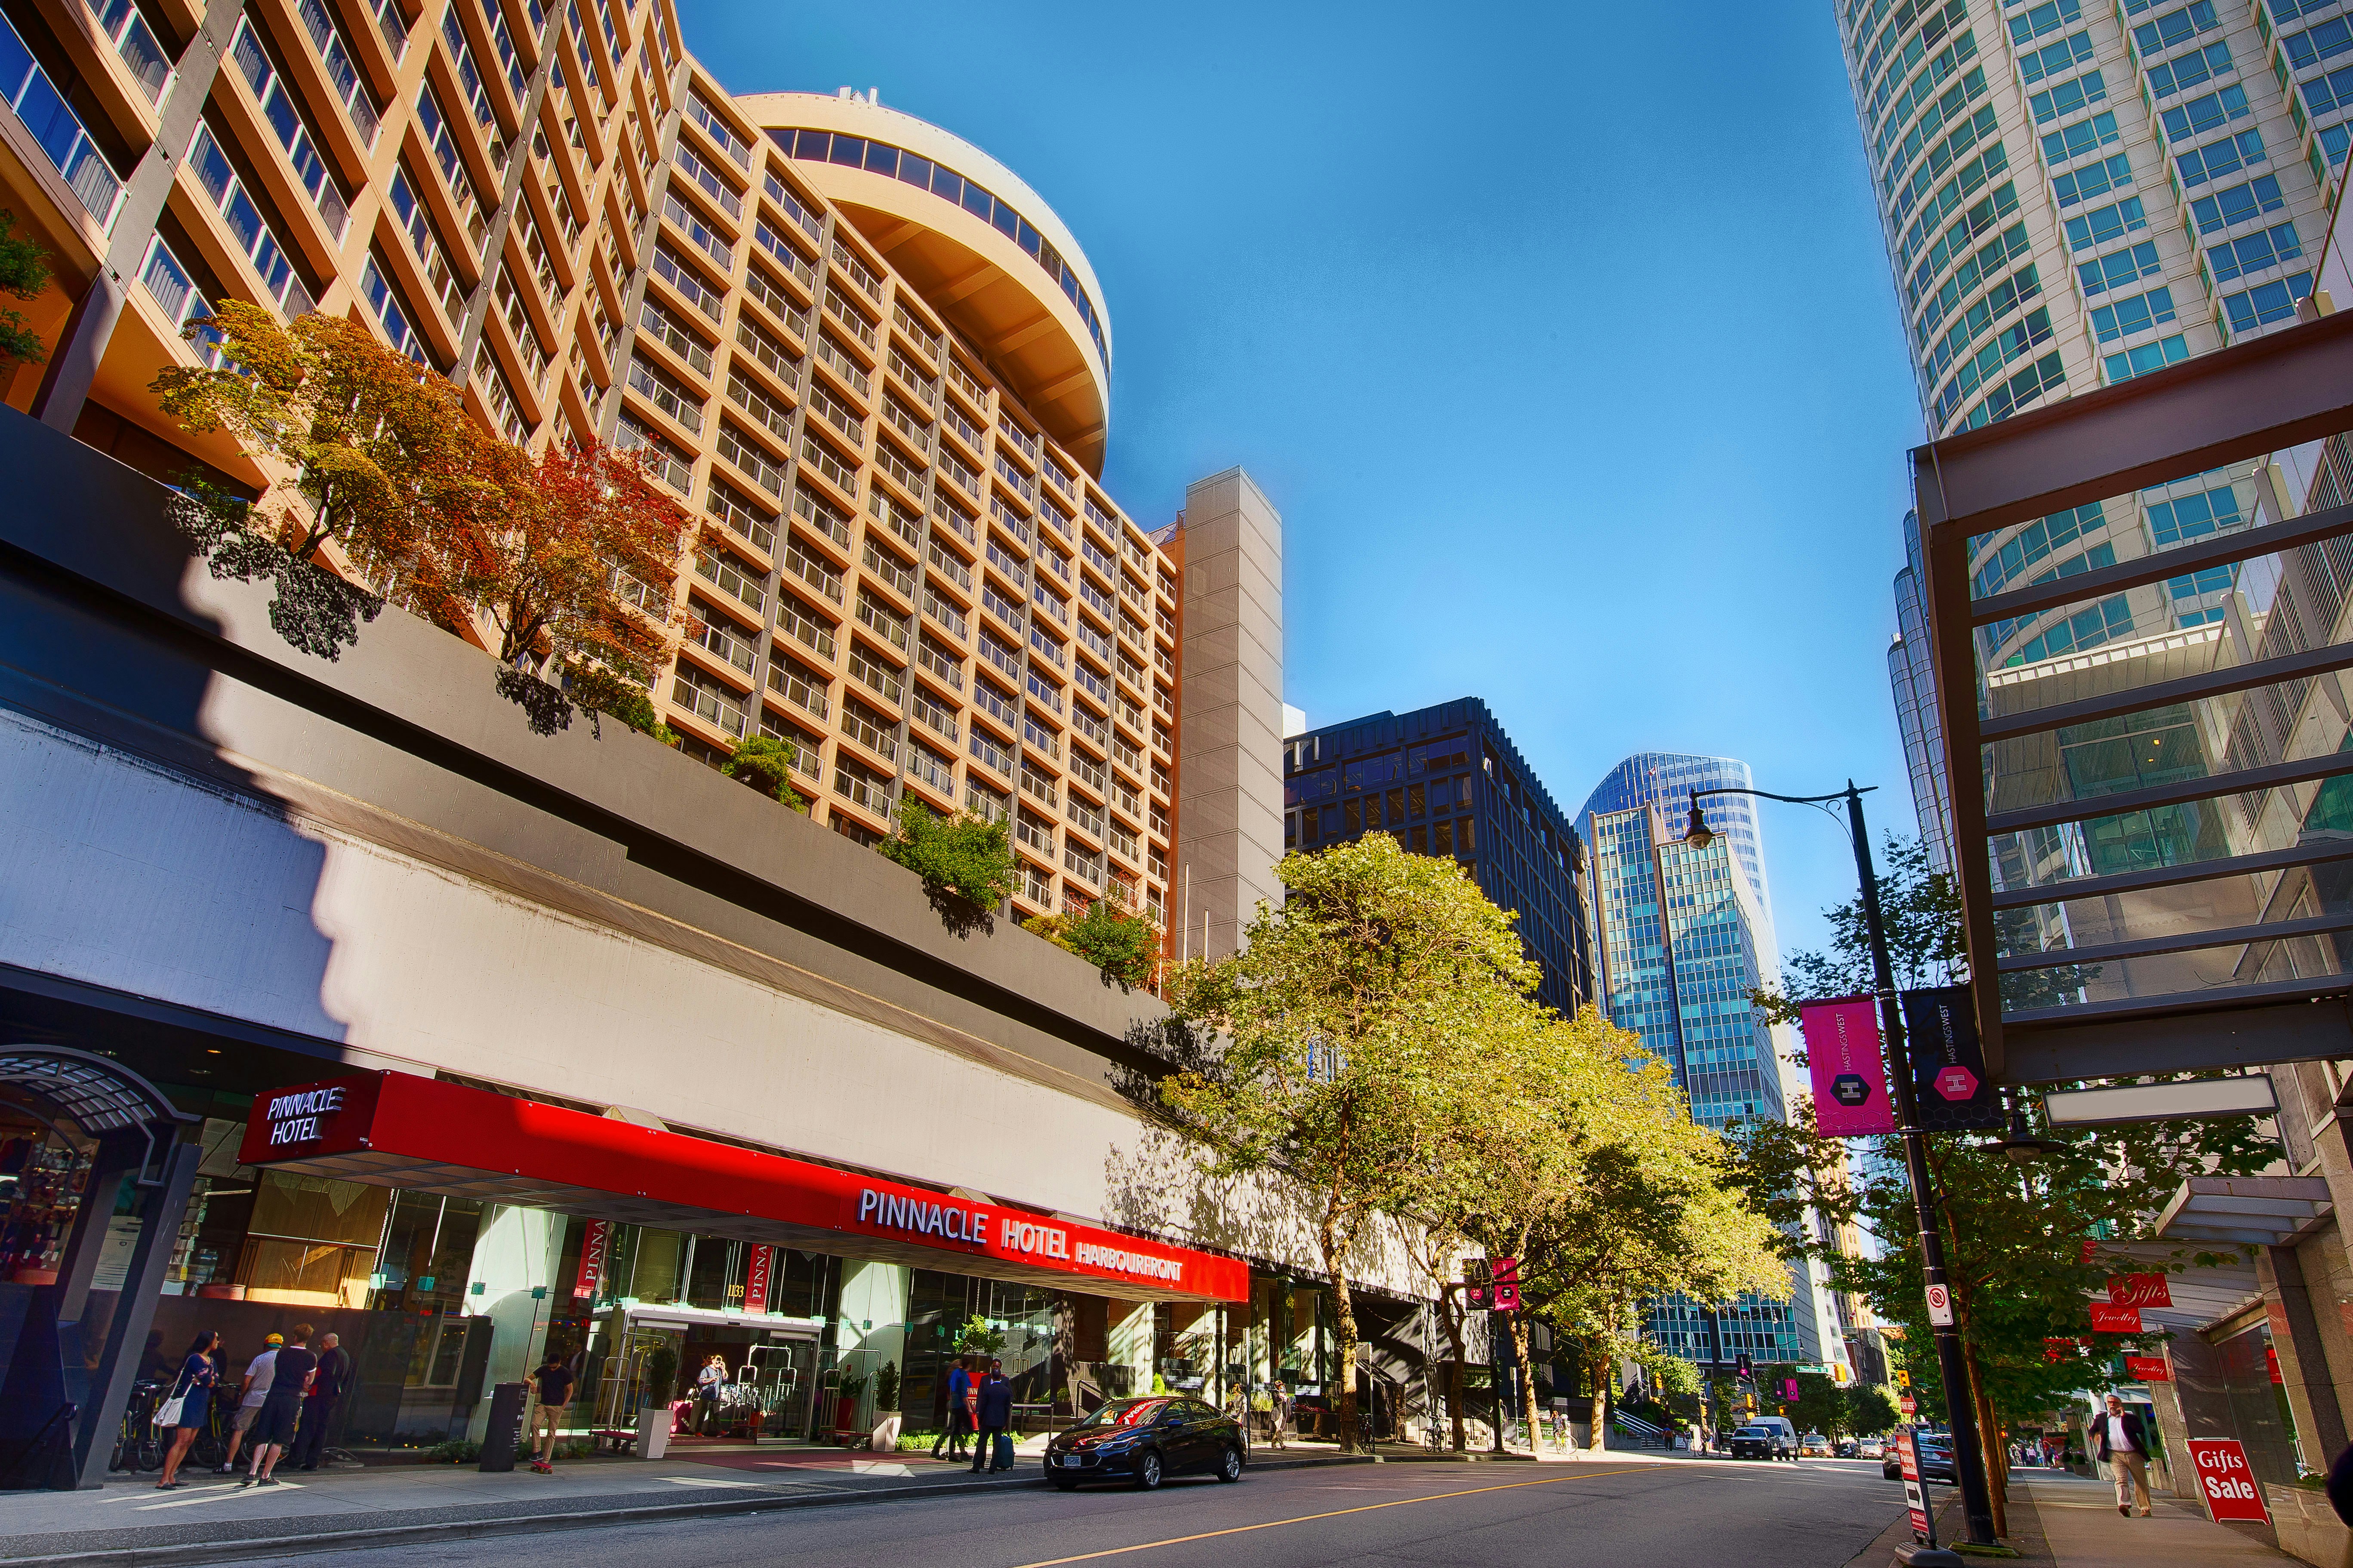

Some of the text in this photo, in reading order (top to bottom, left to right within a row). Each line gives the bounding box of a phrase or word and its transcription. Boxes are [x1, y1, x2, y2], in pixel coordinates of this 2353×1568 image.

[1836, 1013, 1851, 1071] HASTINGSWEST
[1939, 1005, 1956, 1064] HASTINGSWEST
[267, 1087, 341, 1120] PINNACLE
[271, 1116, 318, 1145] HOTEL
[859, 1189, 1183, 1280] PINNACLE HOTEL HARBOURFRONT
[728, 1284, 744, 1297] 1133
[2111, 1276, 2166, 1306] Gifts
[2093, 1310, 2137, 1325] Jewellry
[2198, 1449, 2243, 1473] Gifts
[2205, 1476, 2254, 1500] Sale
